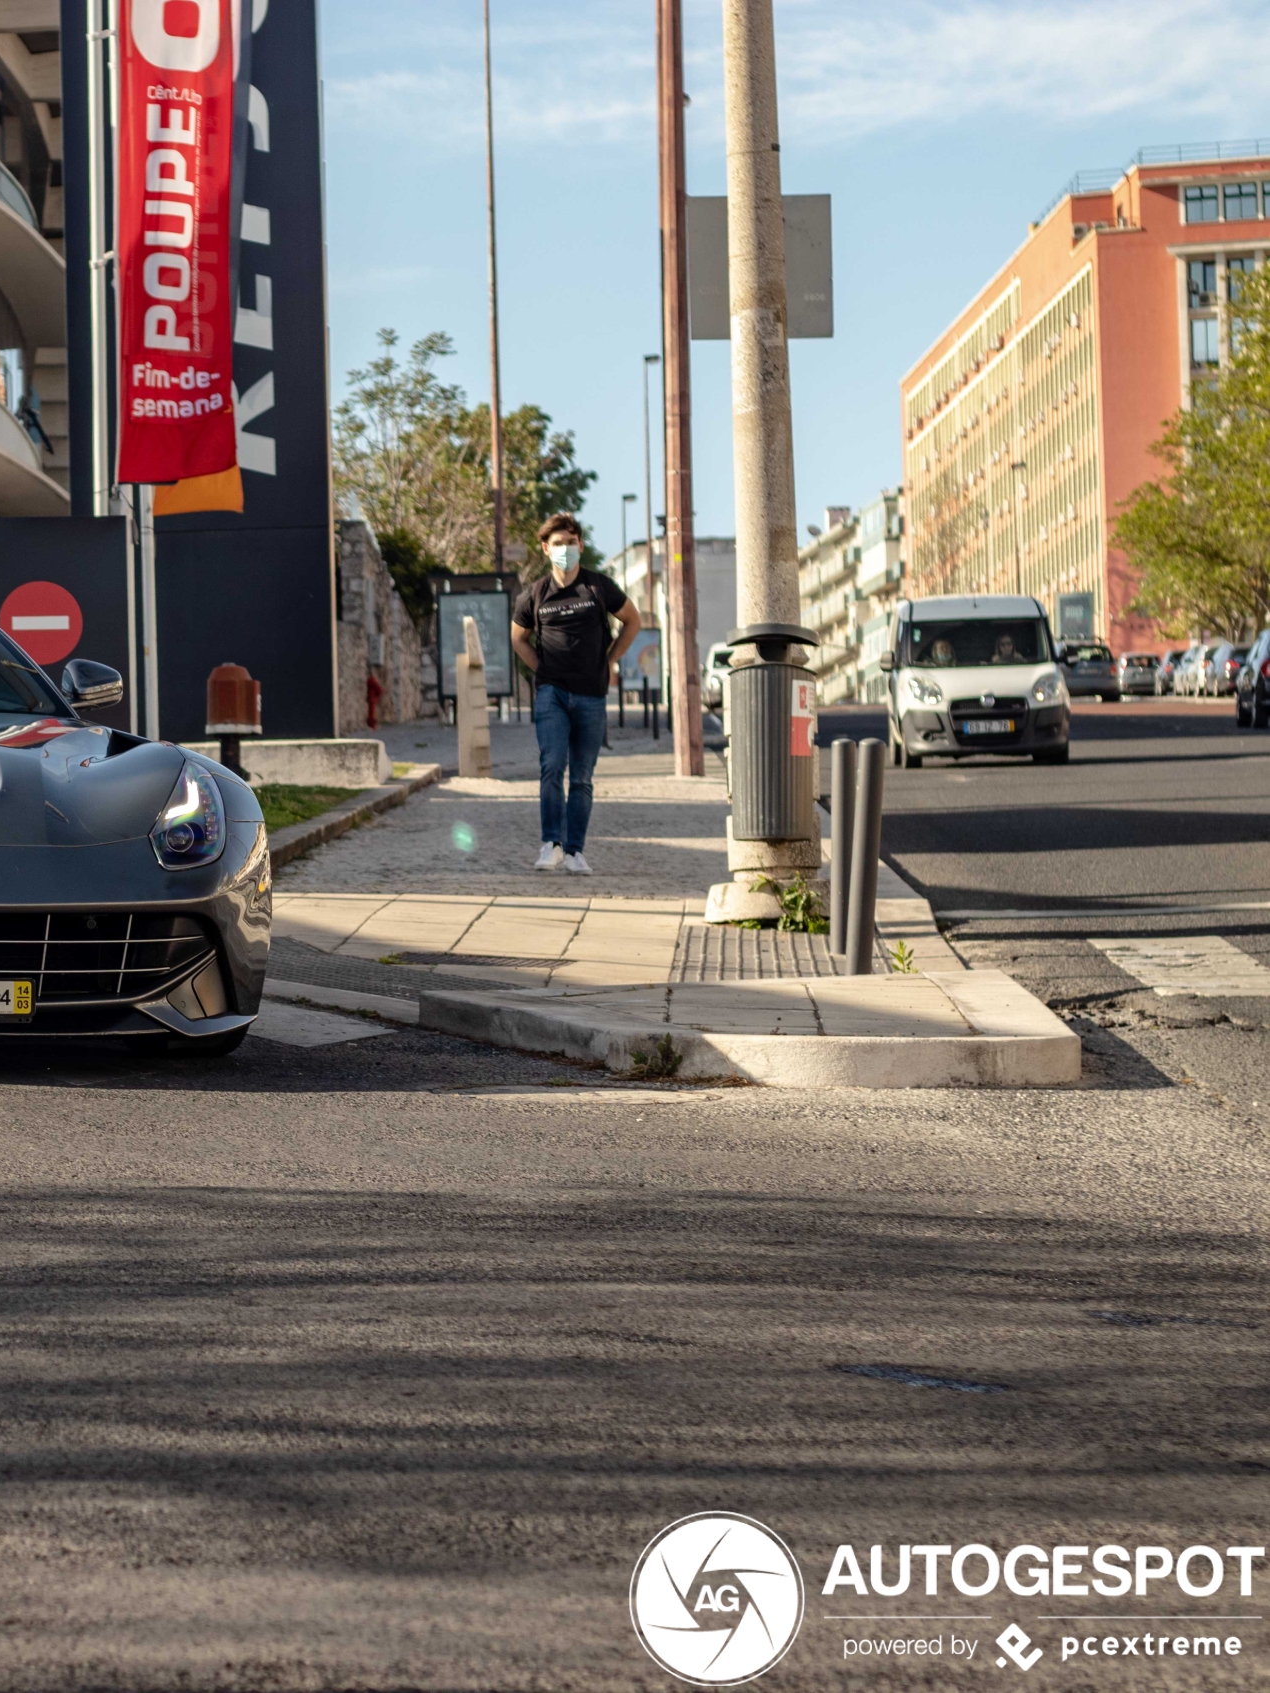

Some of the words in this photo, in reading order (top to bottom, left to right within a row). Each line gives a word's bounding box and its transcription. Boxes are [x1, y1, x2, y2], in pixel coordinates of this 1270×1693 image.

[143, 103, 197, 352] POUPE
[133, 361, 221, 390] Fim-de-
[132, 393, 224, 419] semana
[17, 986, 29, 995] 14
[16, 1000, 29, 1009] 03
